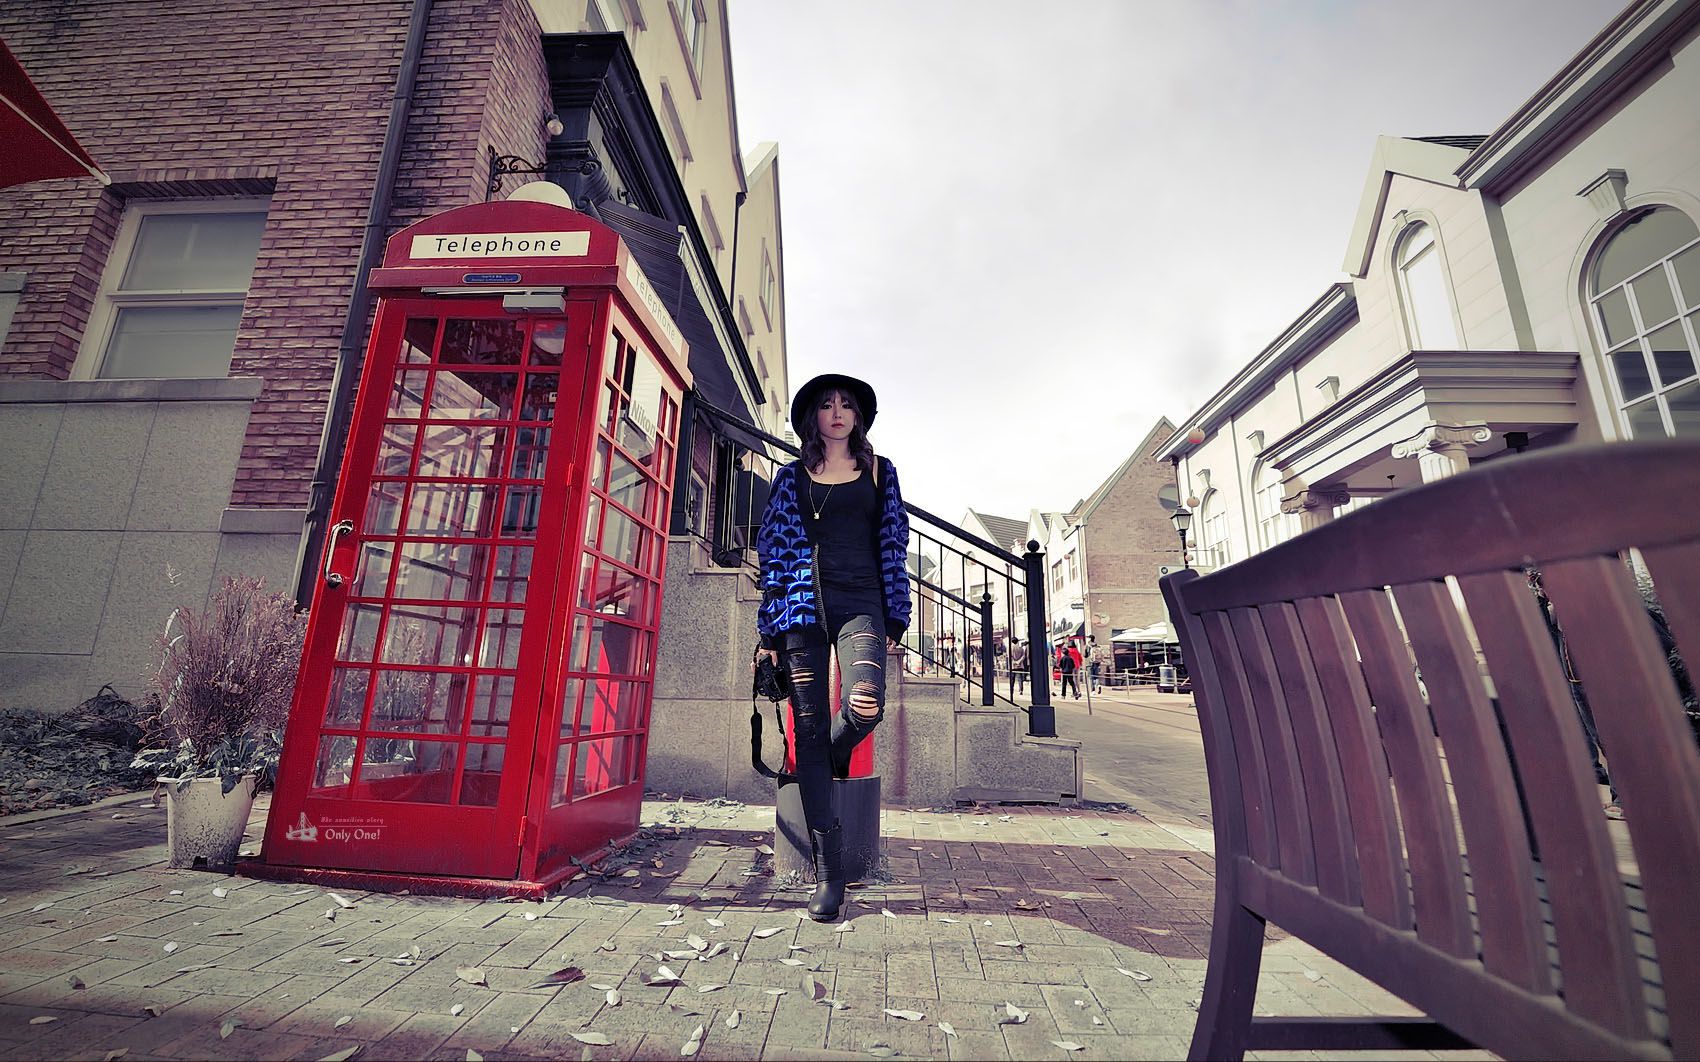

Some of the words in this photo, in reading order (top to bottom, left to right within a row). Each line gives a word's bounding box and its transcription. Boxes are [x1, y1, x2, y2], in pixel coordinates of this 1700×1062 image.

[435, 236, 561, 255] Telephone
[636, 270, 675, 341] Telephone
[630, 399, 656, 438] Nikon
[325, 828, 351, 843] Only
[354, 828, 381, 840] One!
